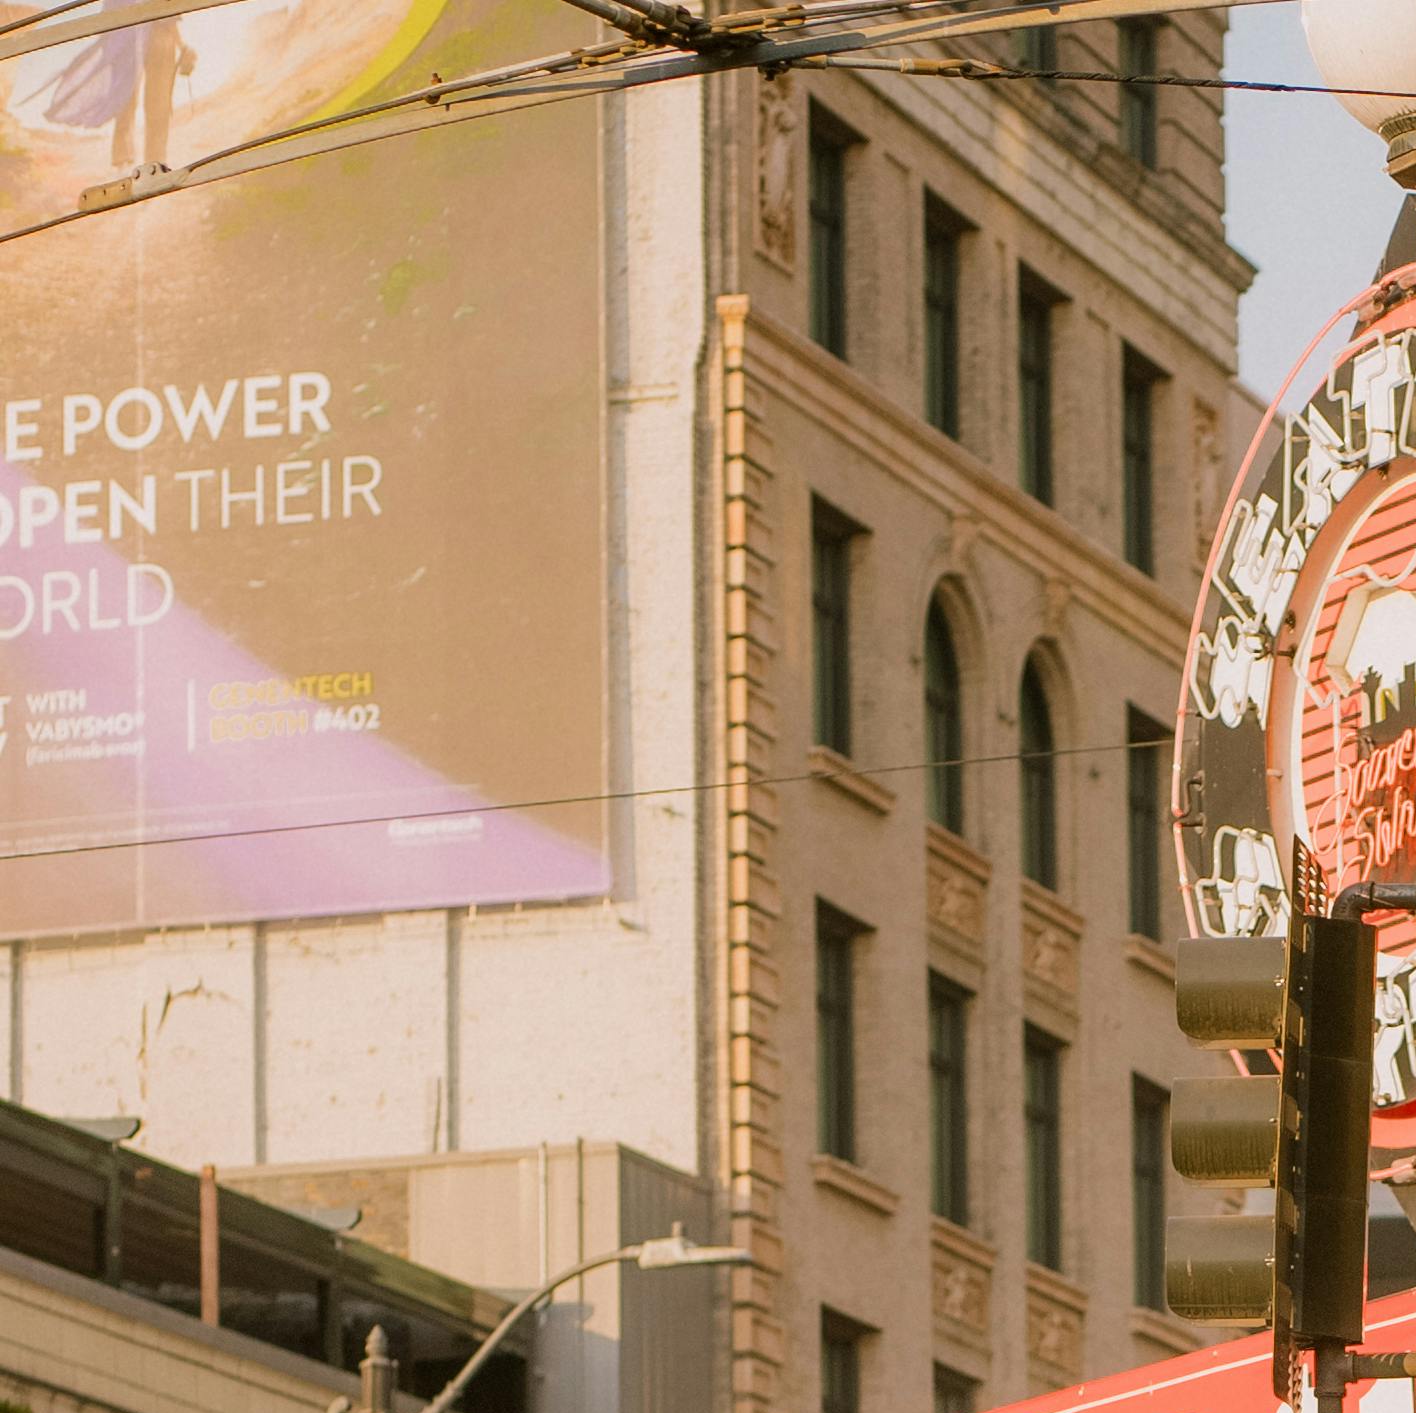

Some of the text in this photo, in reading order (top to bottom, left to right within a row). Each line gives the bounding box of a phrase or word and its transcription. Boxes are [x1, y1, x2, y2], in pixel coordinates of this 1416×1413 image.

[63, 372, 333, 456] POWER
[0, 455, 382, 549] PEN THEIR
[26, 688, 87, 715] WITH
[208, 671, 374, 709] GENENTECH
[210, 702, 381, 742] BOOTH #402
